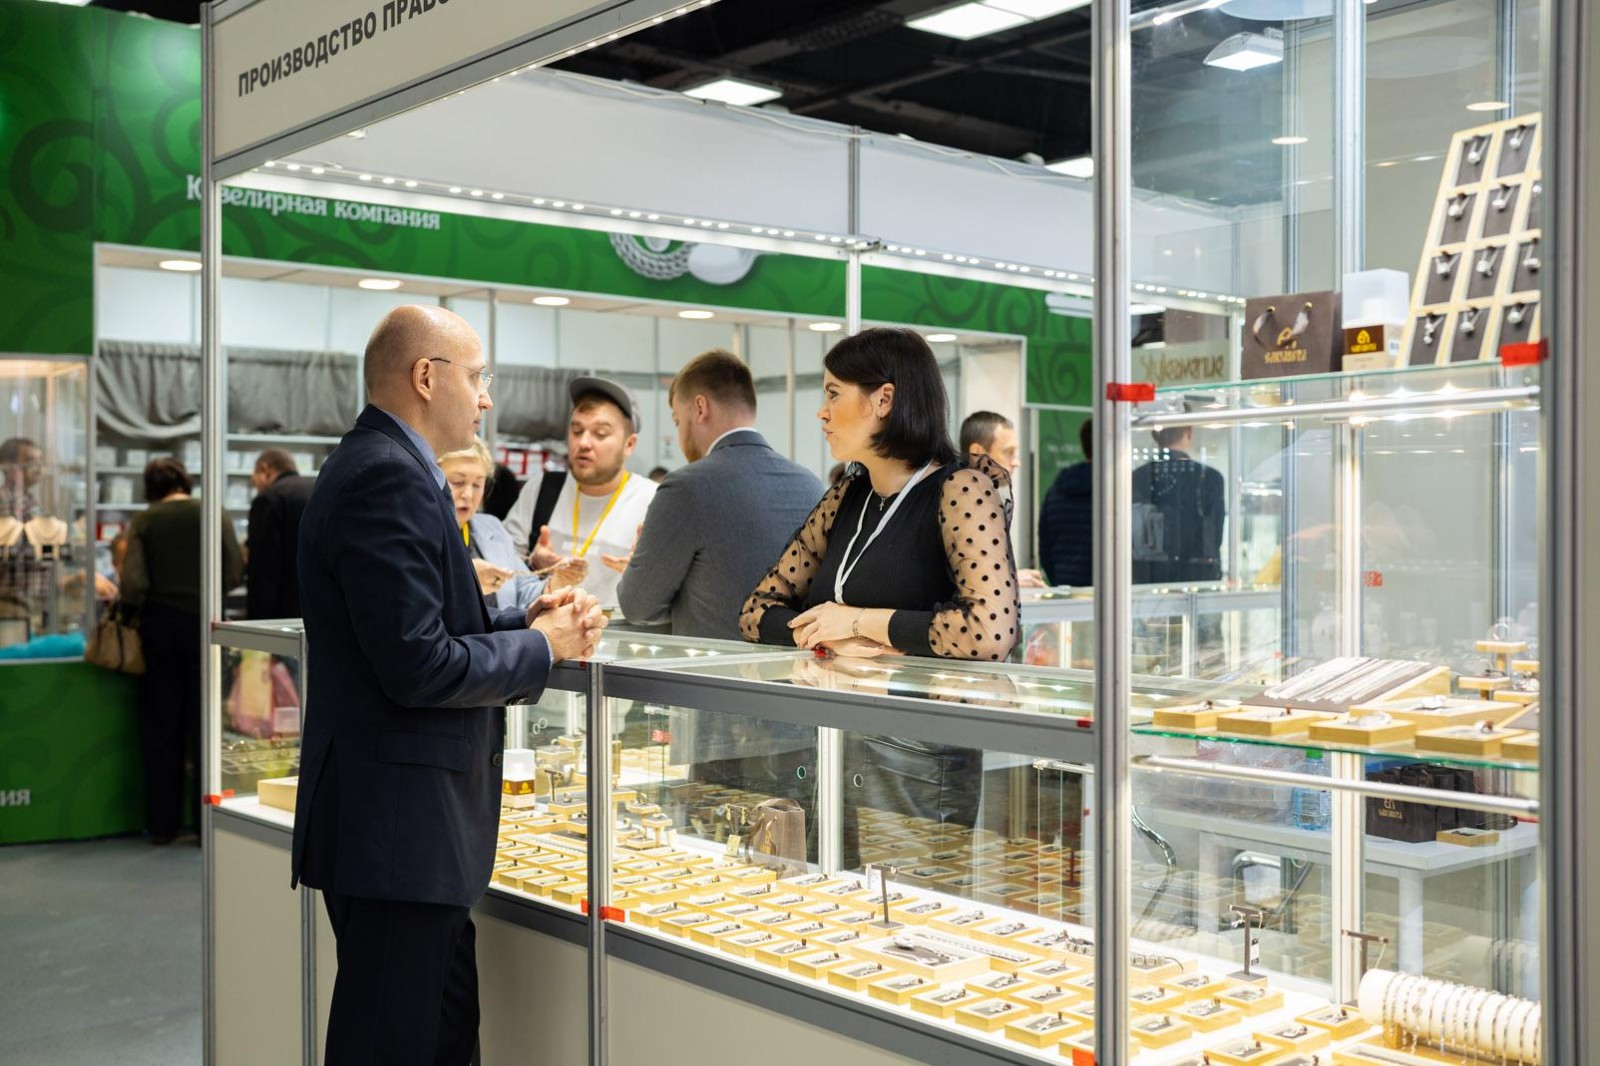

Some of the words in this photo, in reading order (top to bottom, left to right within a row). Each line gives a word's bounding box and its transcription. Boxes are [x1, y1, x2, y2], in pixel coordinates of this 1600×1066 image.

[238, 11, 377, 98] ПРОИЗВОДСТВО
[382, 0, 450, 32] ПРАВ
[333, 201, 441, 230] компания
